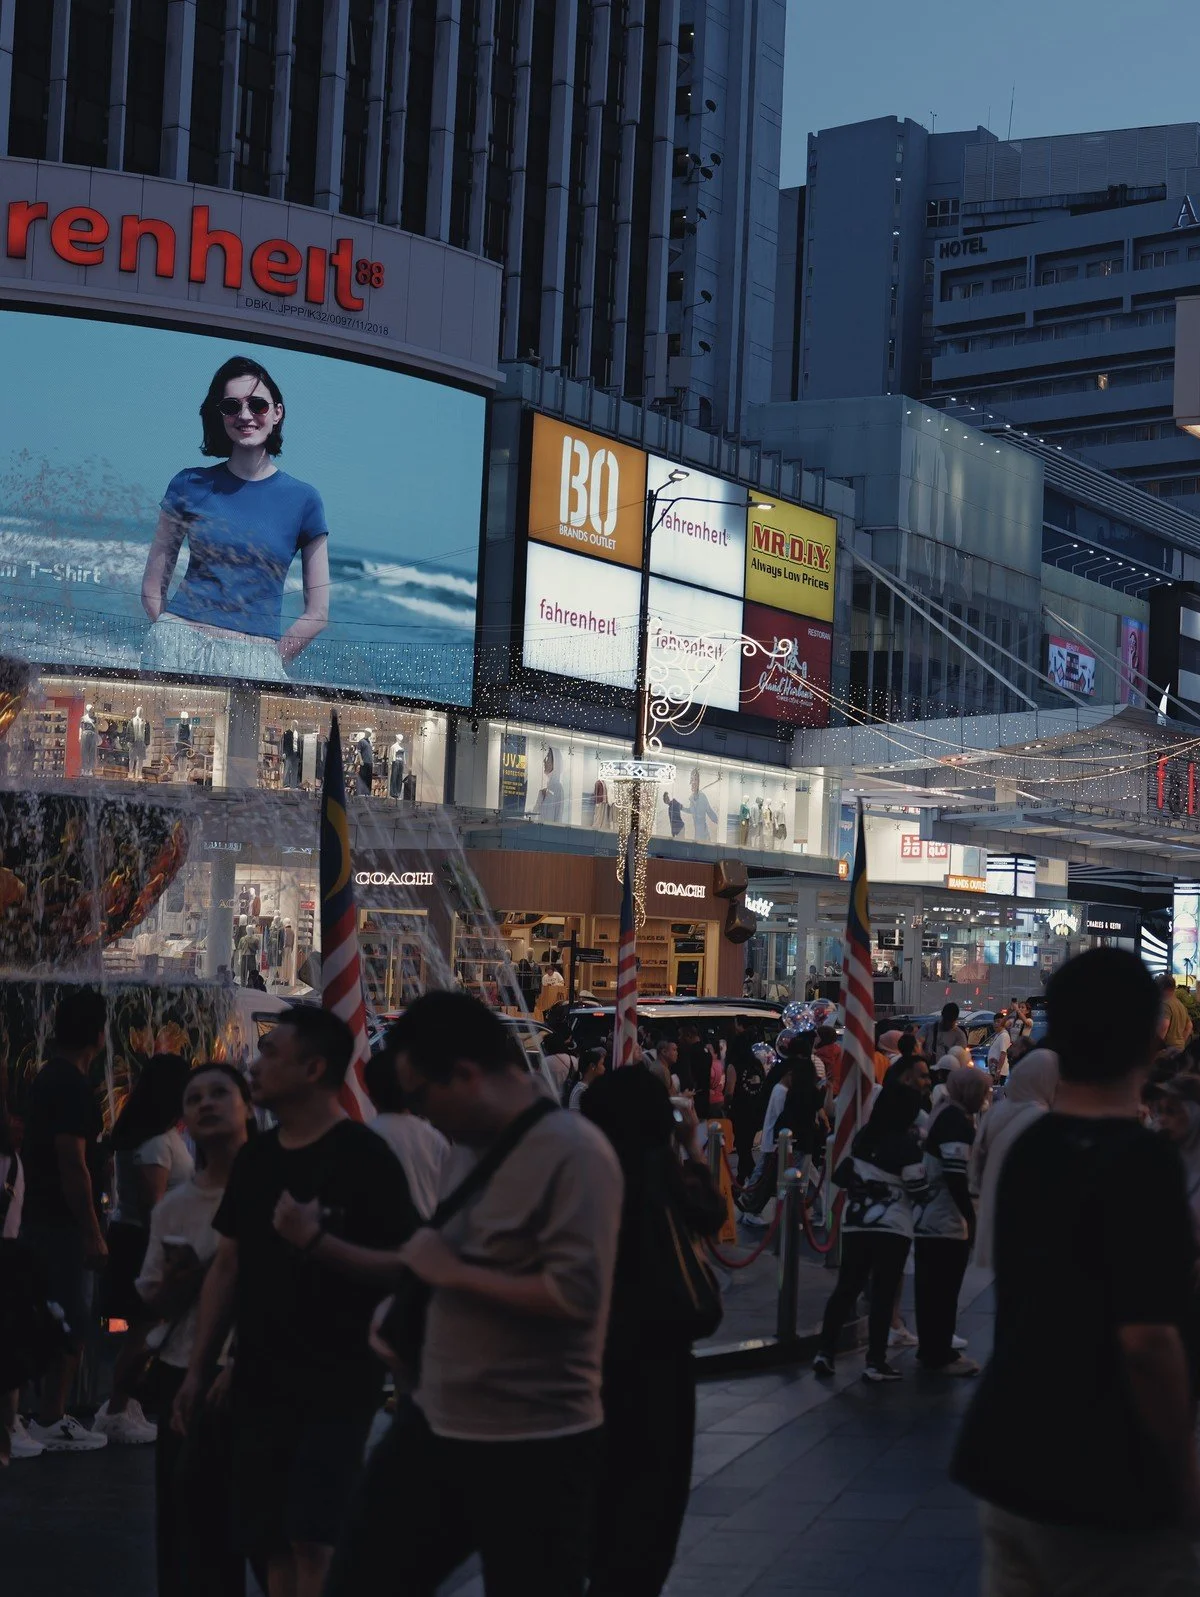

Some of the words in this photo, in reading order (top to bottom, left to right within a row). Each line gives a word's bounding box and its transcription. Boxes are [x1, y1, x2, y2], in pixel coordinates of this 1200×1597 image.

[938, 235, 988, 260] HOTEL
[559, 435, 620, 536] BO
[558, 523, 588, 543] BRANDS
[589, 534, 617, 551] OUTLET
[27, 560, 101, 583] T-Shirt
[751, 557, 782, 579] Always
[783, 567, 801, 583] Low
[802, 573, 829, 591] Prices
[539, 598, 617, 637] fahrenheit
[807, 627, 831, 641] RESTORAN
[355, 871, 434, 886] COACH
[655, 881, 706, 899] COACH
[949, 877, 970, 891] BRANDS
[969, 879, 986, 891] OUTLE
[1087, 920, 1104, 929] CHARLES
[1105, 921, 1109, 929] &
[1110, 922, 1121, 931] KEITH
